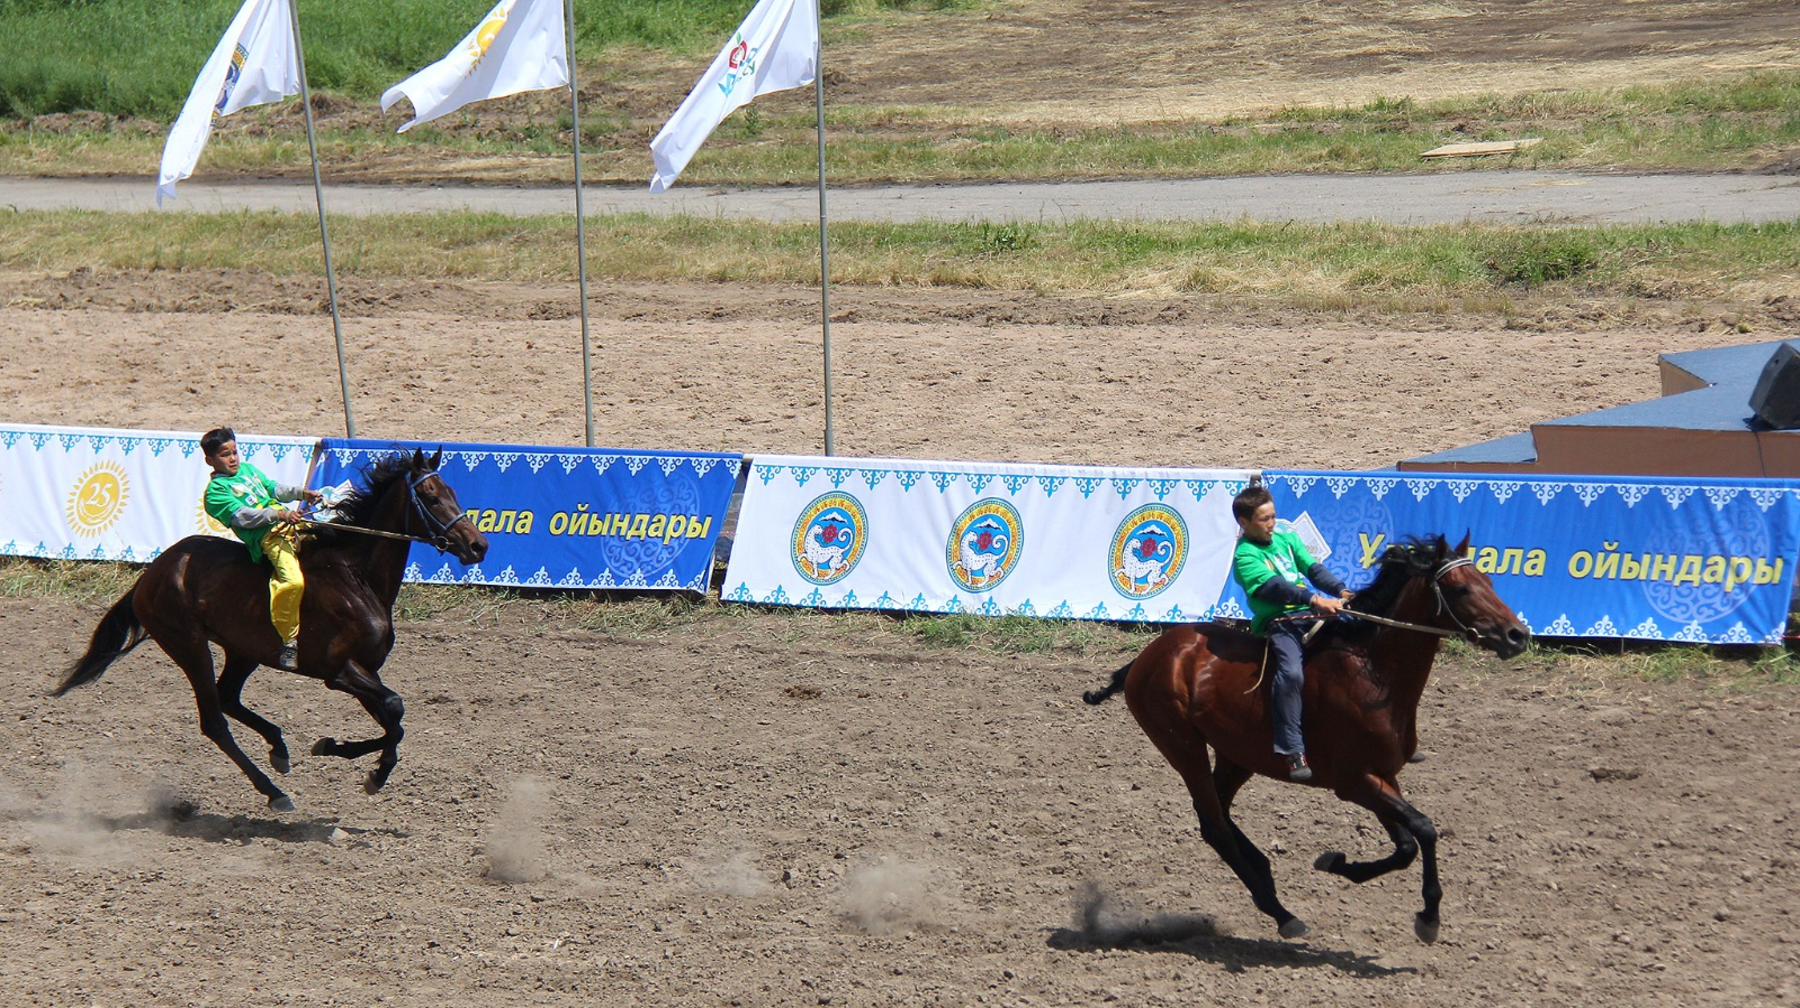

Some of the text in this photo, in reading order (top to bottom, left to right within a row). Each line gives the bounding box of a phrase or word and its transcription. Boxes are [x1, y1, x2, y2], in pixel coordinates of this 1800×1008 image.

[85, 482, 113, 507] 25
[549, 503, 713, 544] ойындары
[1467, 546, 1547, 576] ала
[1568, 541, 1784, 591] ойындары
